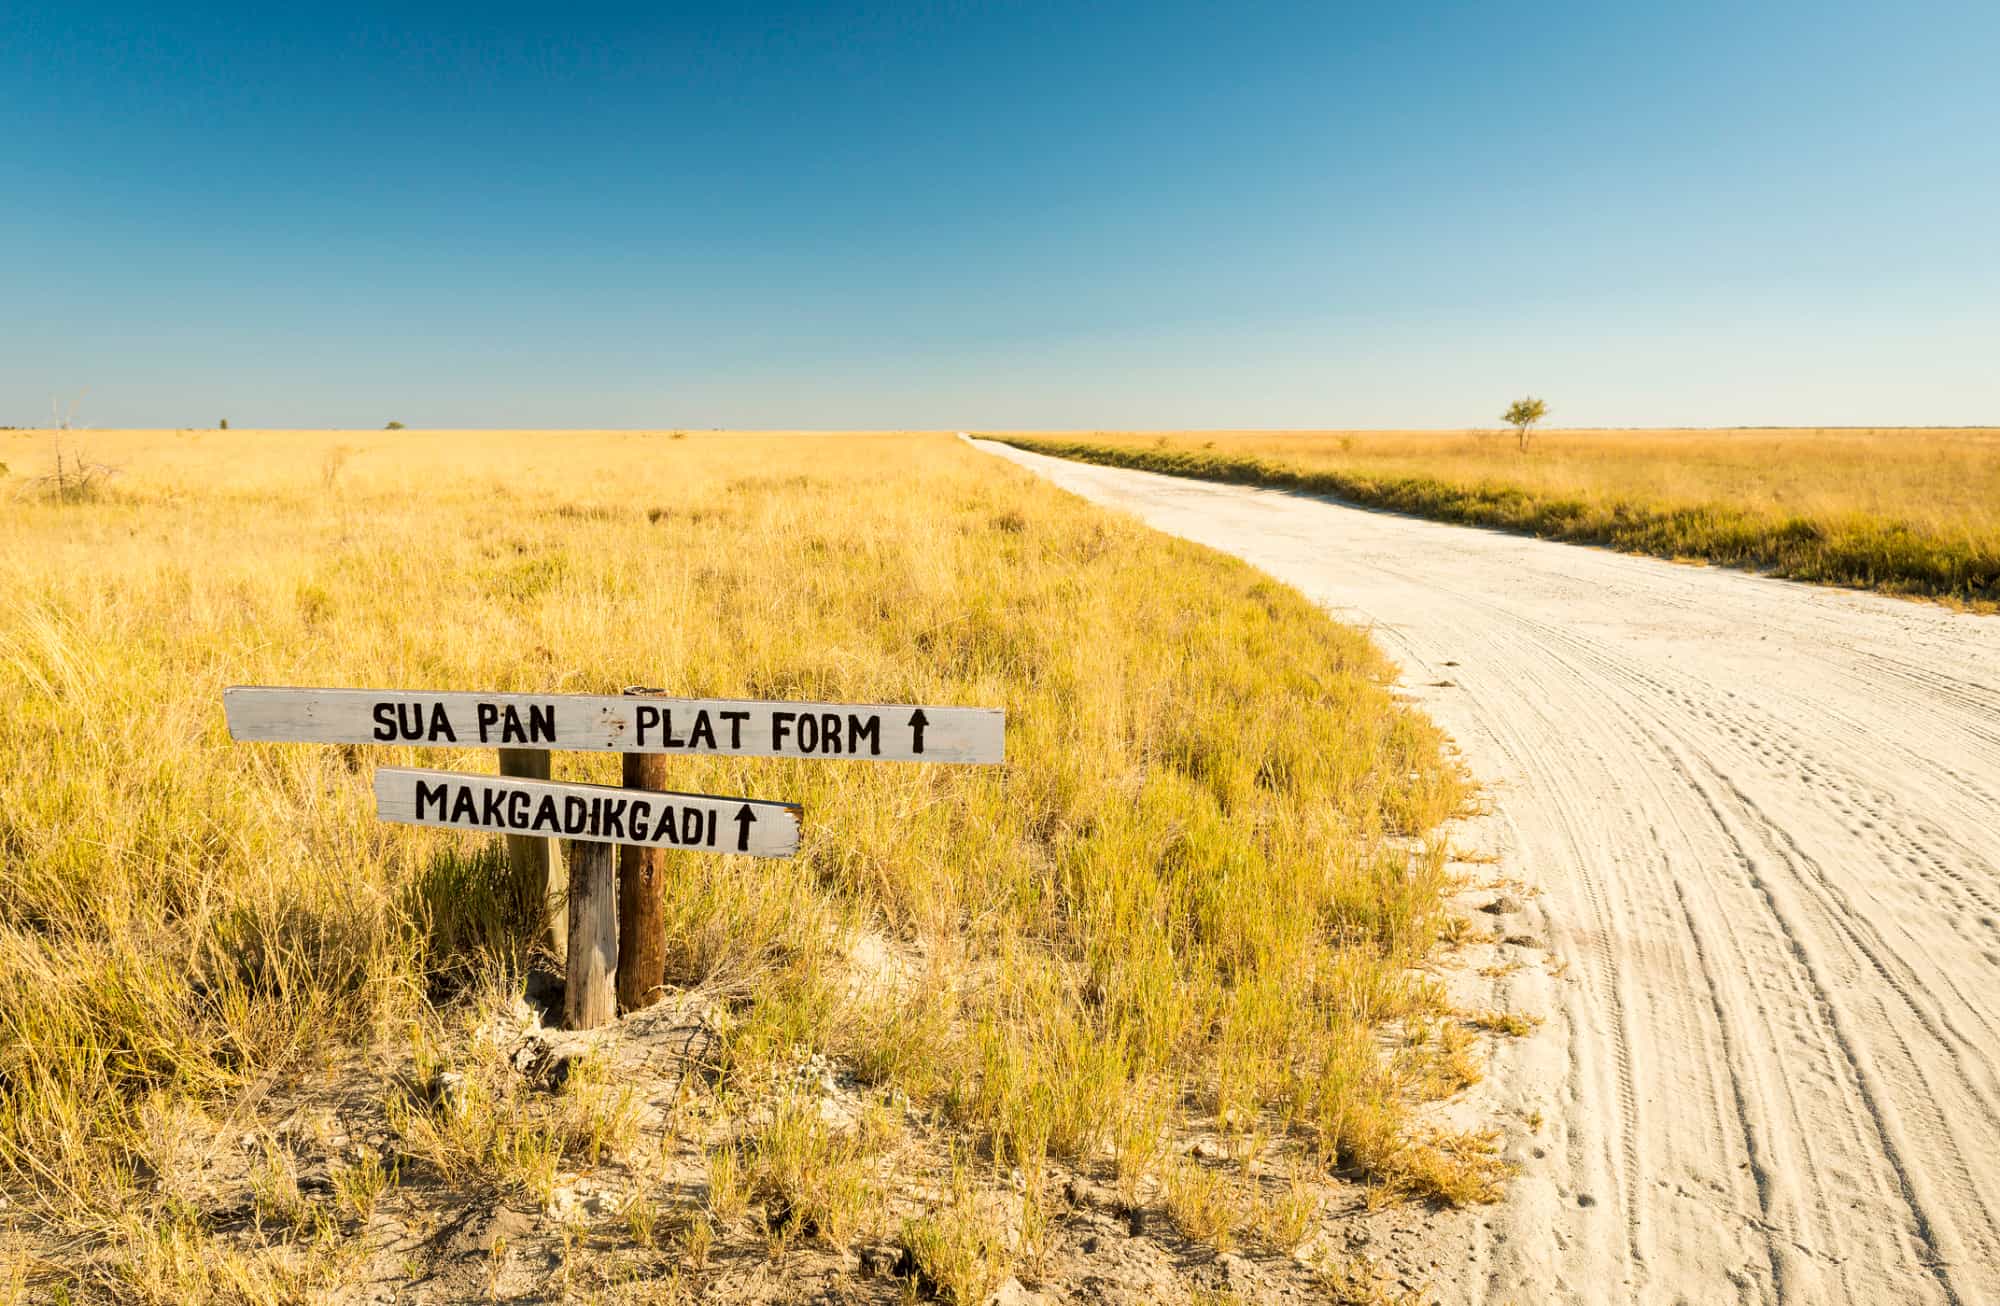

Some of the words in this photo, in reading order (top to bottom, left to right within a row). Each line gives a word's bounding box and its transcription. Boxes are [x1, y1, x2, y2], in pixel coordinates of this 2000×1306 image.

[372, 701, 457, 744] SUA
[476, 702, 557, 745] PAN
[635, 704, 751, 750] PLAT
[771, 710, 882, 757] FORM
[414, 779, 718, 848] MAKGADIKGADI
